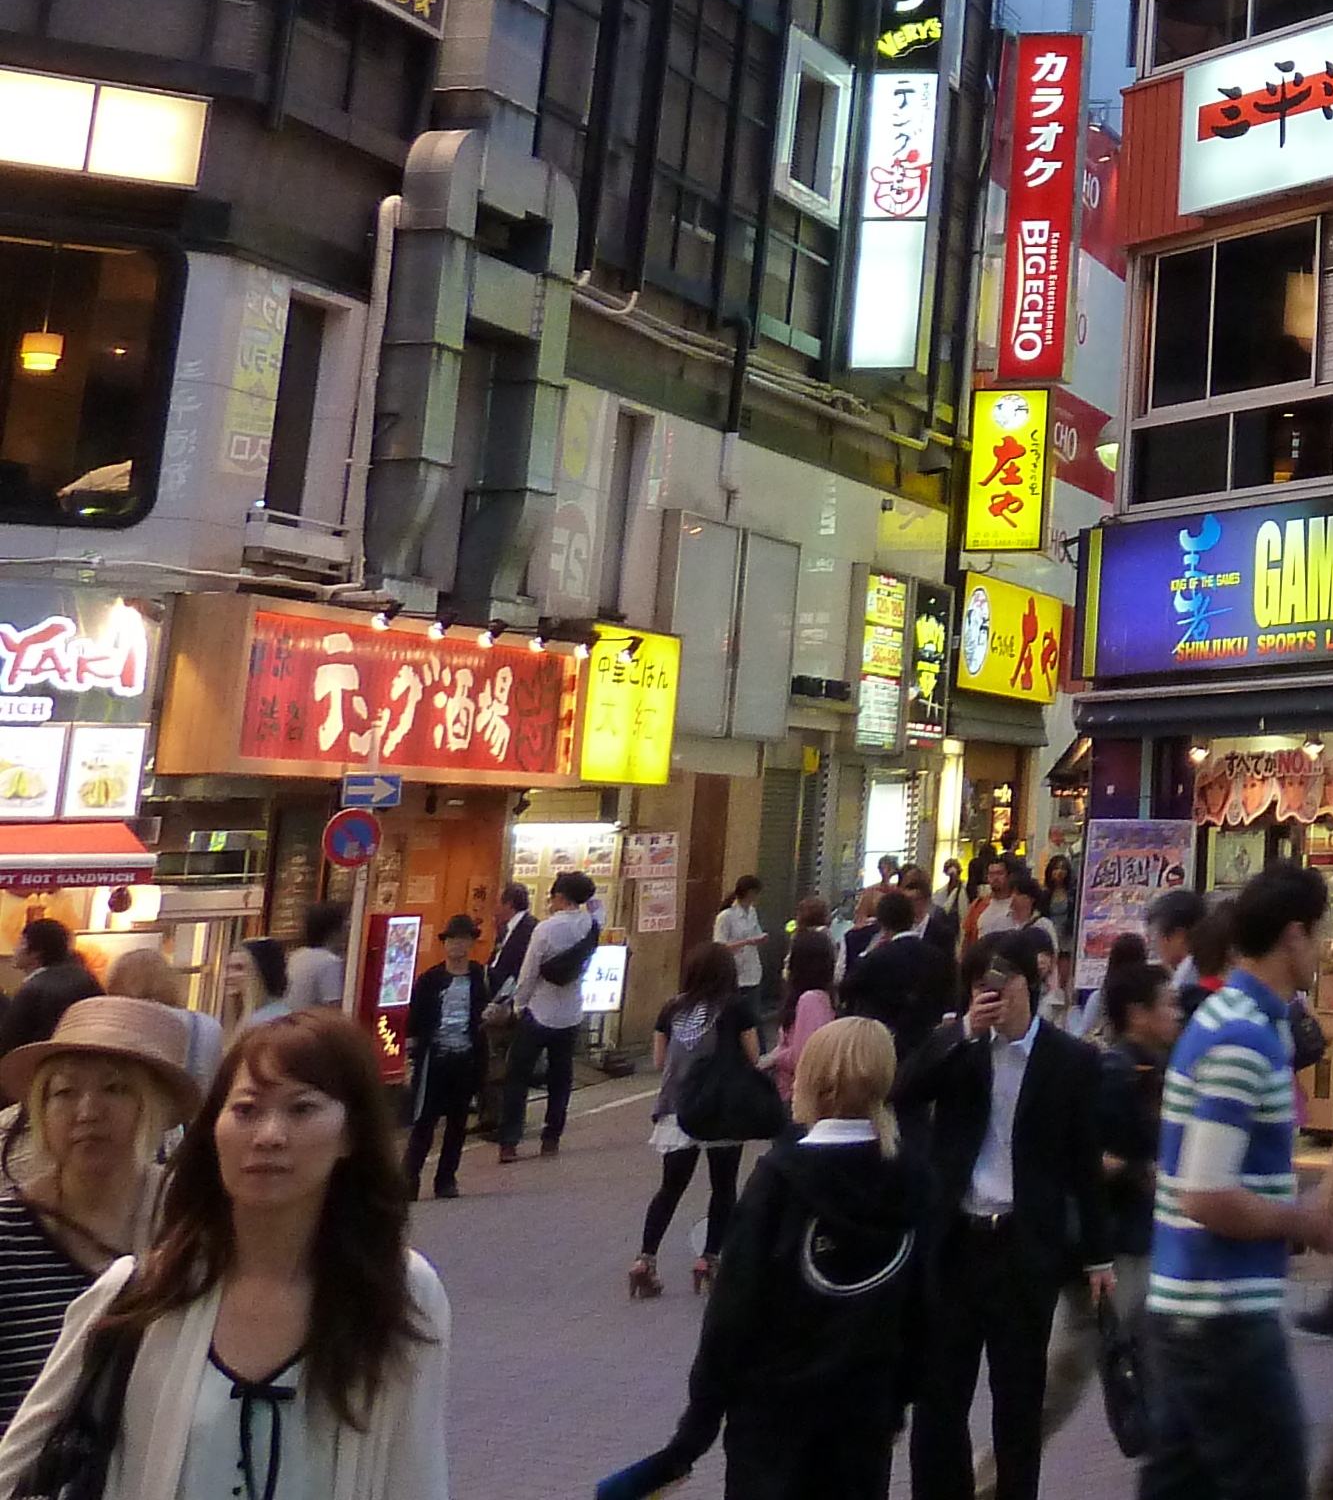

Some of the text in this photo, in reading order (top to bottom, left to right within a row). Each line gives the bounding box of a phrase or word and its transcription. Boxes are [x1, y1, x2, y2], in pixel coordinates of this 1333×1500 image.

[877, 17, 943, 57] VERY'S
[1003, 52, 1068, 188] カラオケ
[1013, 220, 1051, 362] BIG ECHO
[977, 434, 1027, 529] 庄や
[1189, 577, 1199, 590] OF
[1201, 575, 1215, 588] THE
[1216, 572, 1241, 587] GAMES
[1009, 596, 1059, 698] 庄や
[1175, 636, 1249, 663] SHINJUKU
[1257, 631, 1317, 655] SPORTS
[21, 873, 52, 886] HOT
[57, 871, 136, 885] SANDWICH
